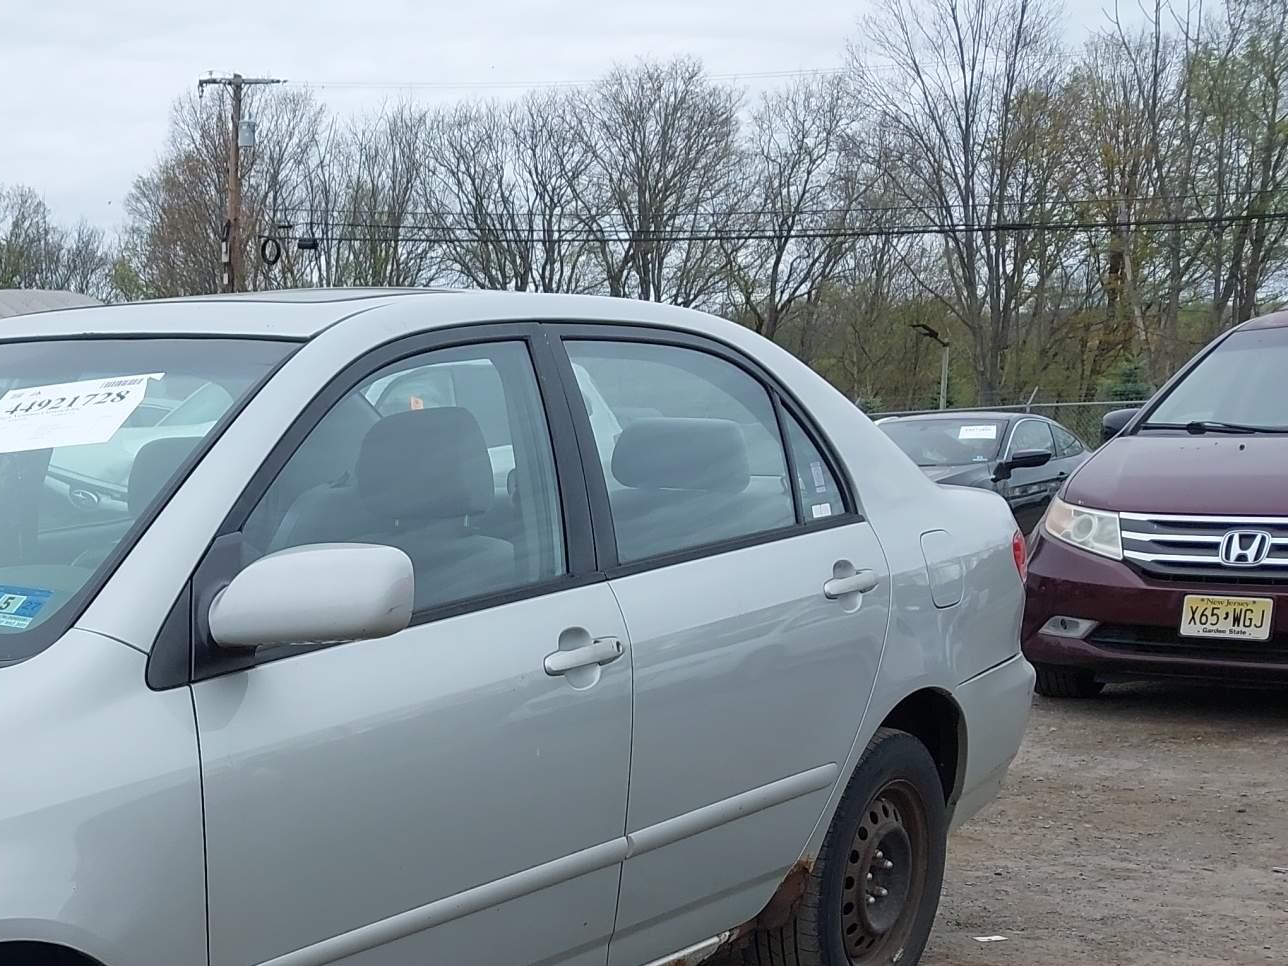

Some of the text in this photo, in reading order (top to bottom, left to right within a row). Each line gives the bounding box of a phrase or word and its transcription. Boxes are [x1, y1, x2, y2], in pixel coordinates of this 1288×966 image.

[4, 390, 131, 415] 44921728
[0, 597, 16, 610] 5
[1206, 597, 1249, 607] New Jersey
